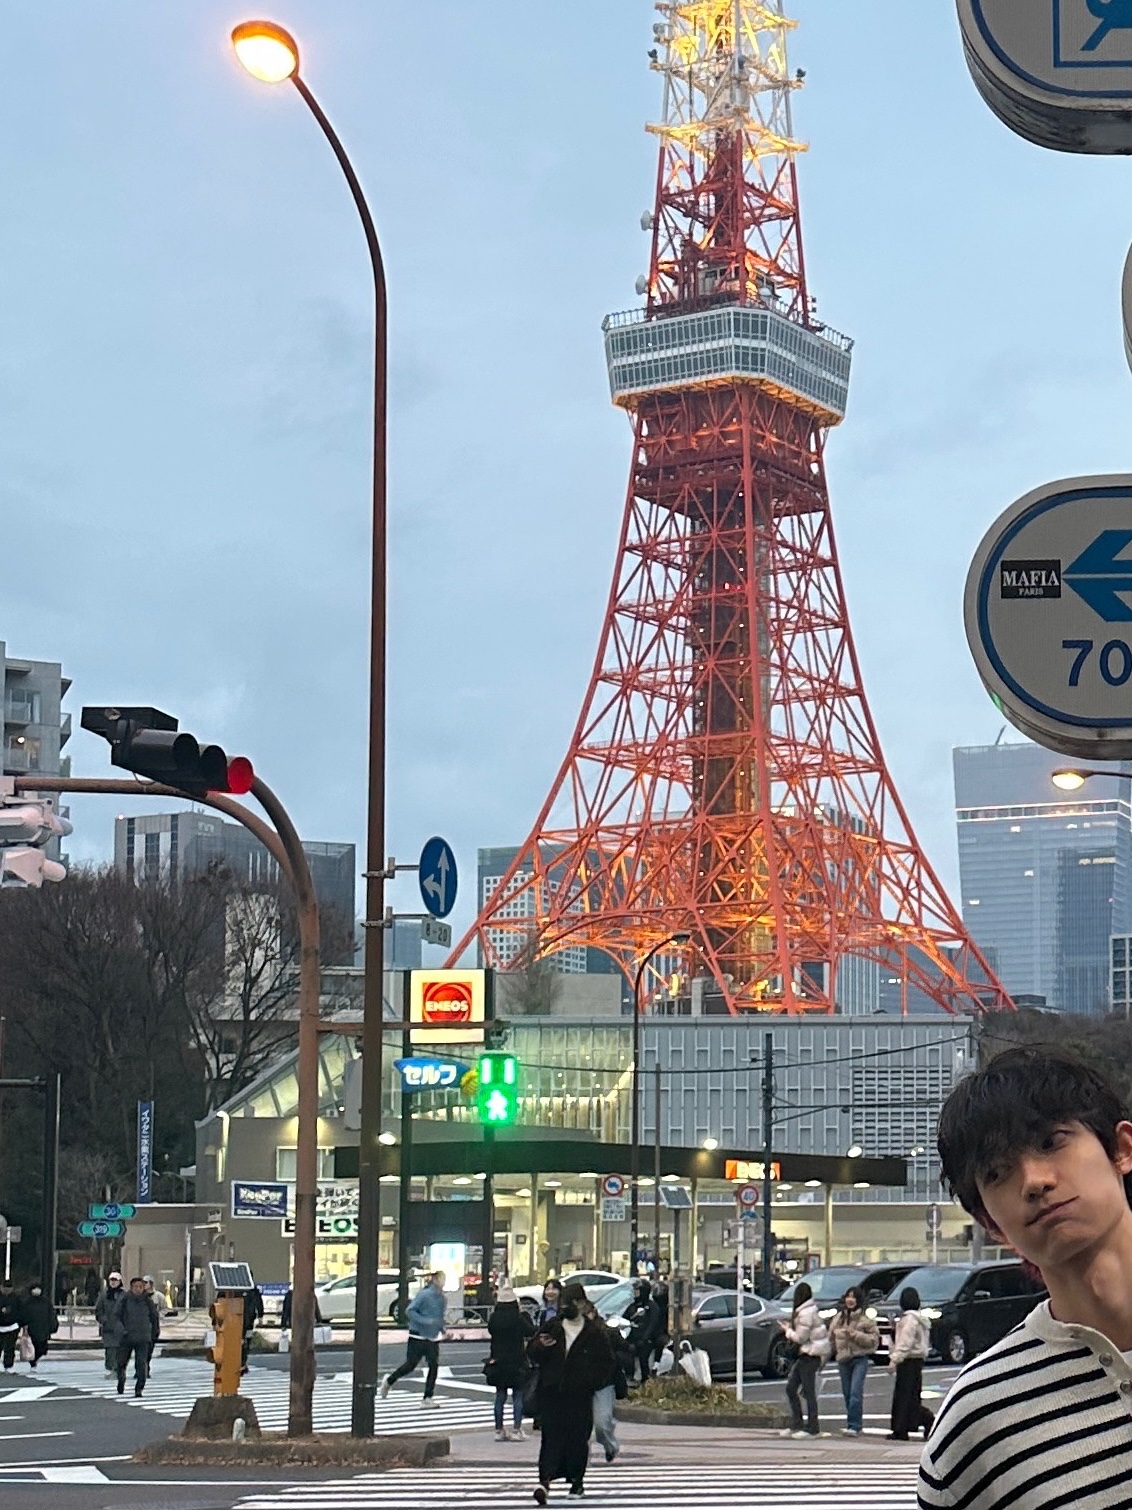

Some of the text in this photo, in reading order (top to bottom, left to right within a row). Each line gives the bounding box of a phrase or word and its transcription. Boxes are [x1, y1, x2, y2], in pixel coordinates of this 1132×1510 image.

[1002, 570, 1060, 588] MAFIA
[425, 1001, 469, 1012] ENEOS
[403, 1064, 458, 1086] セルフ
